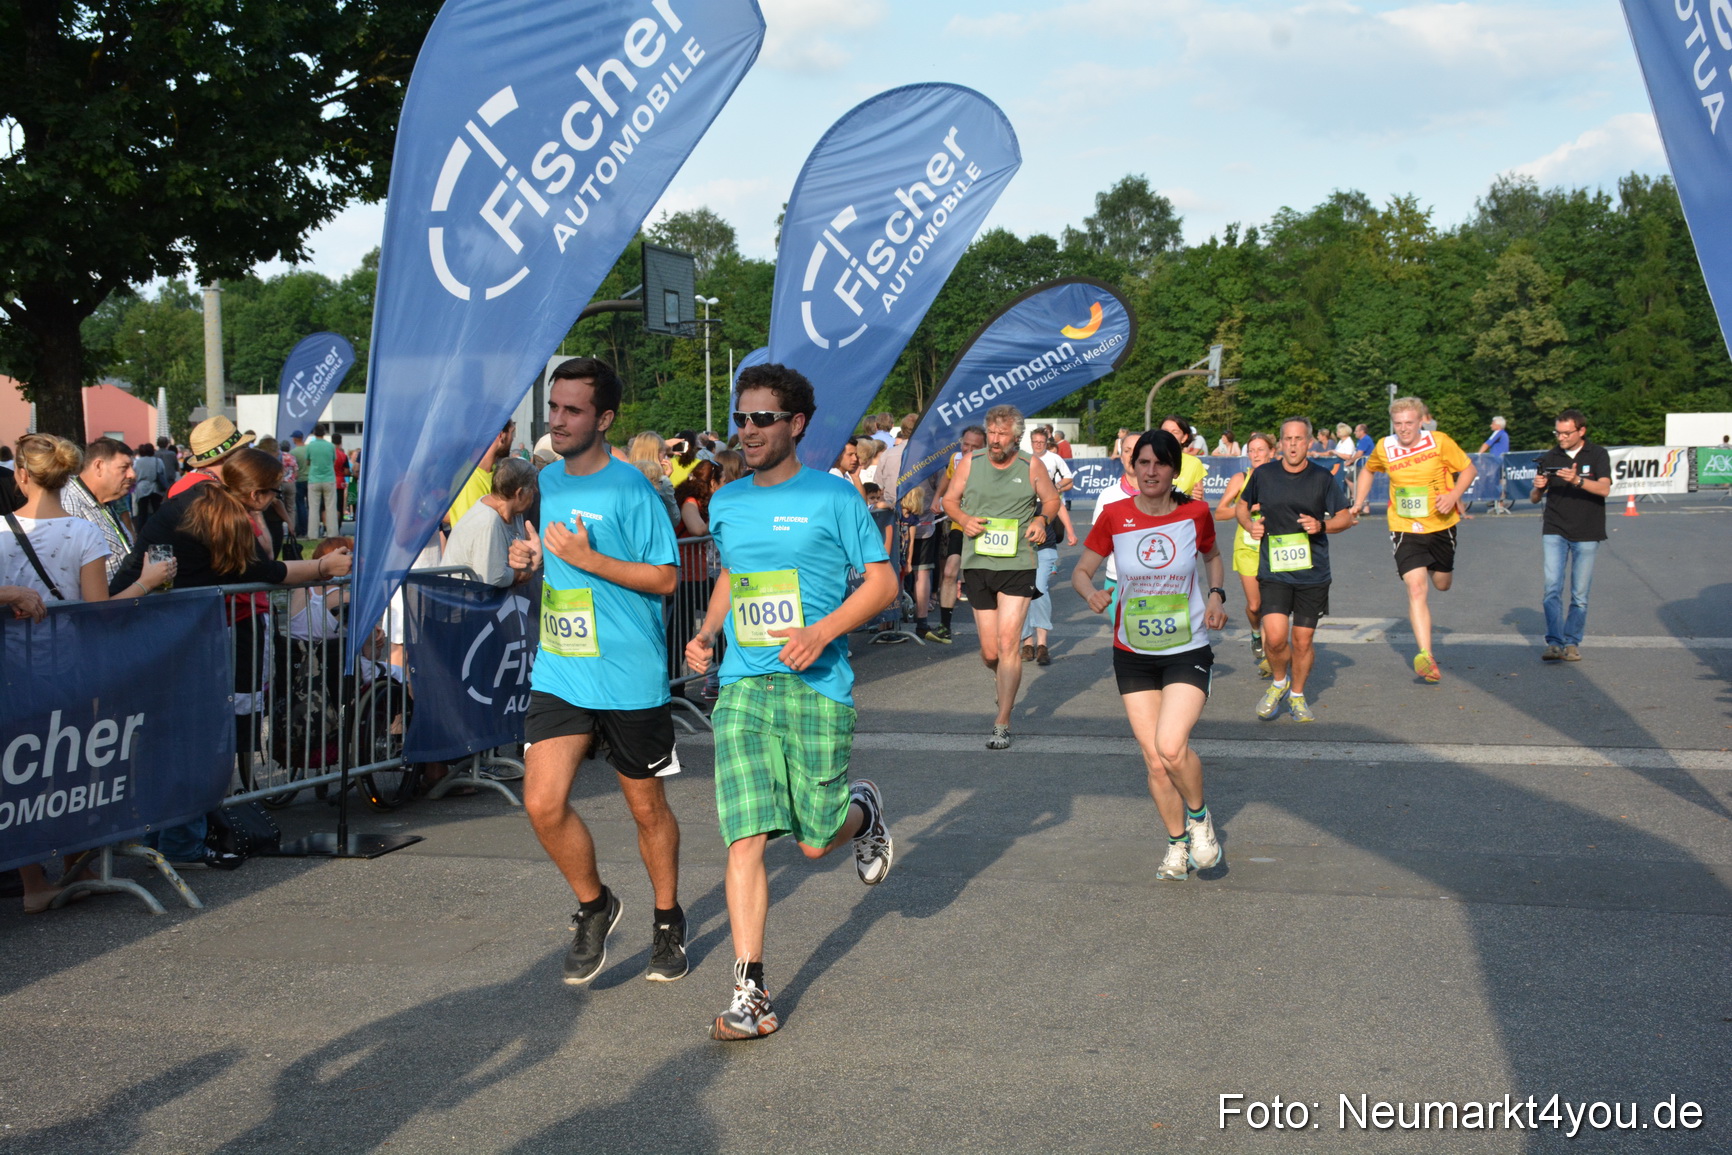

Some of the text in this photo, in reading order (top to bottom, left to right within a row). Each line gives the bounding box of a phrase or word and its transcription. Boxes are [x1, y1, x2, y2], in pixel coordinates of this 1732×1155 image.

[479, 0, 683, 255] Fischer
[553, 36, 706, 254] AUTOMOBILE
[833, 126, 965, 316] Fischer
[881, 161, 982, 314] AUTOMOBILE
[296, 346, 339, 407] Fischer
[1026, 333, 1123, 391] Druck und Medien
[311, 358, 344, 407] AUTOMOBILE
[937, 342, 1075, 426] Frischmann
[1389, 460, 1412, 473] MAX
[1616, 458, 1659, 479] swn
[1401, 498, 1421, 509] 888
[983, 532, 1009, 546] 500
[1273, 547, 1306, 562] 1309
[543, 612, 588, 638] 1093
[738, 600, 794, 626] 1080
[1138, 617, 1177, 637] 538
